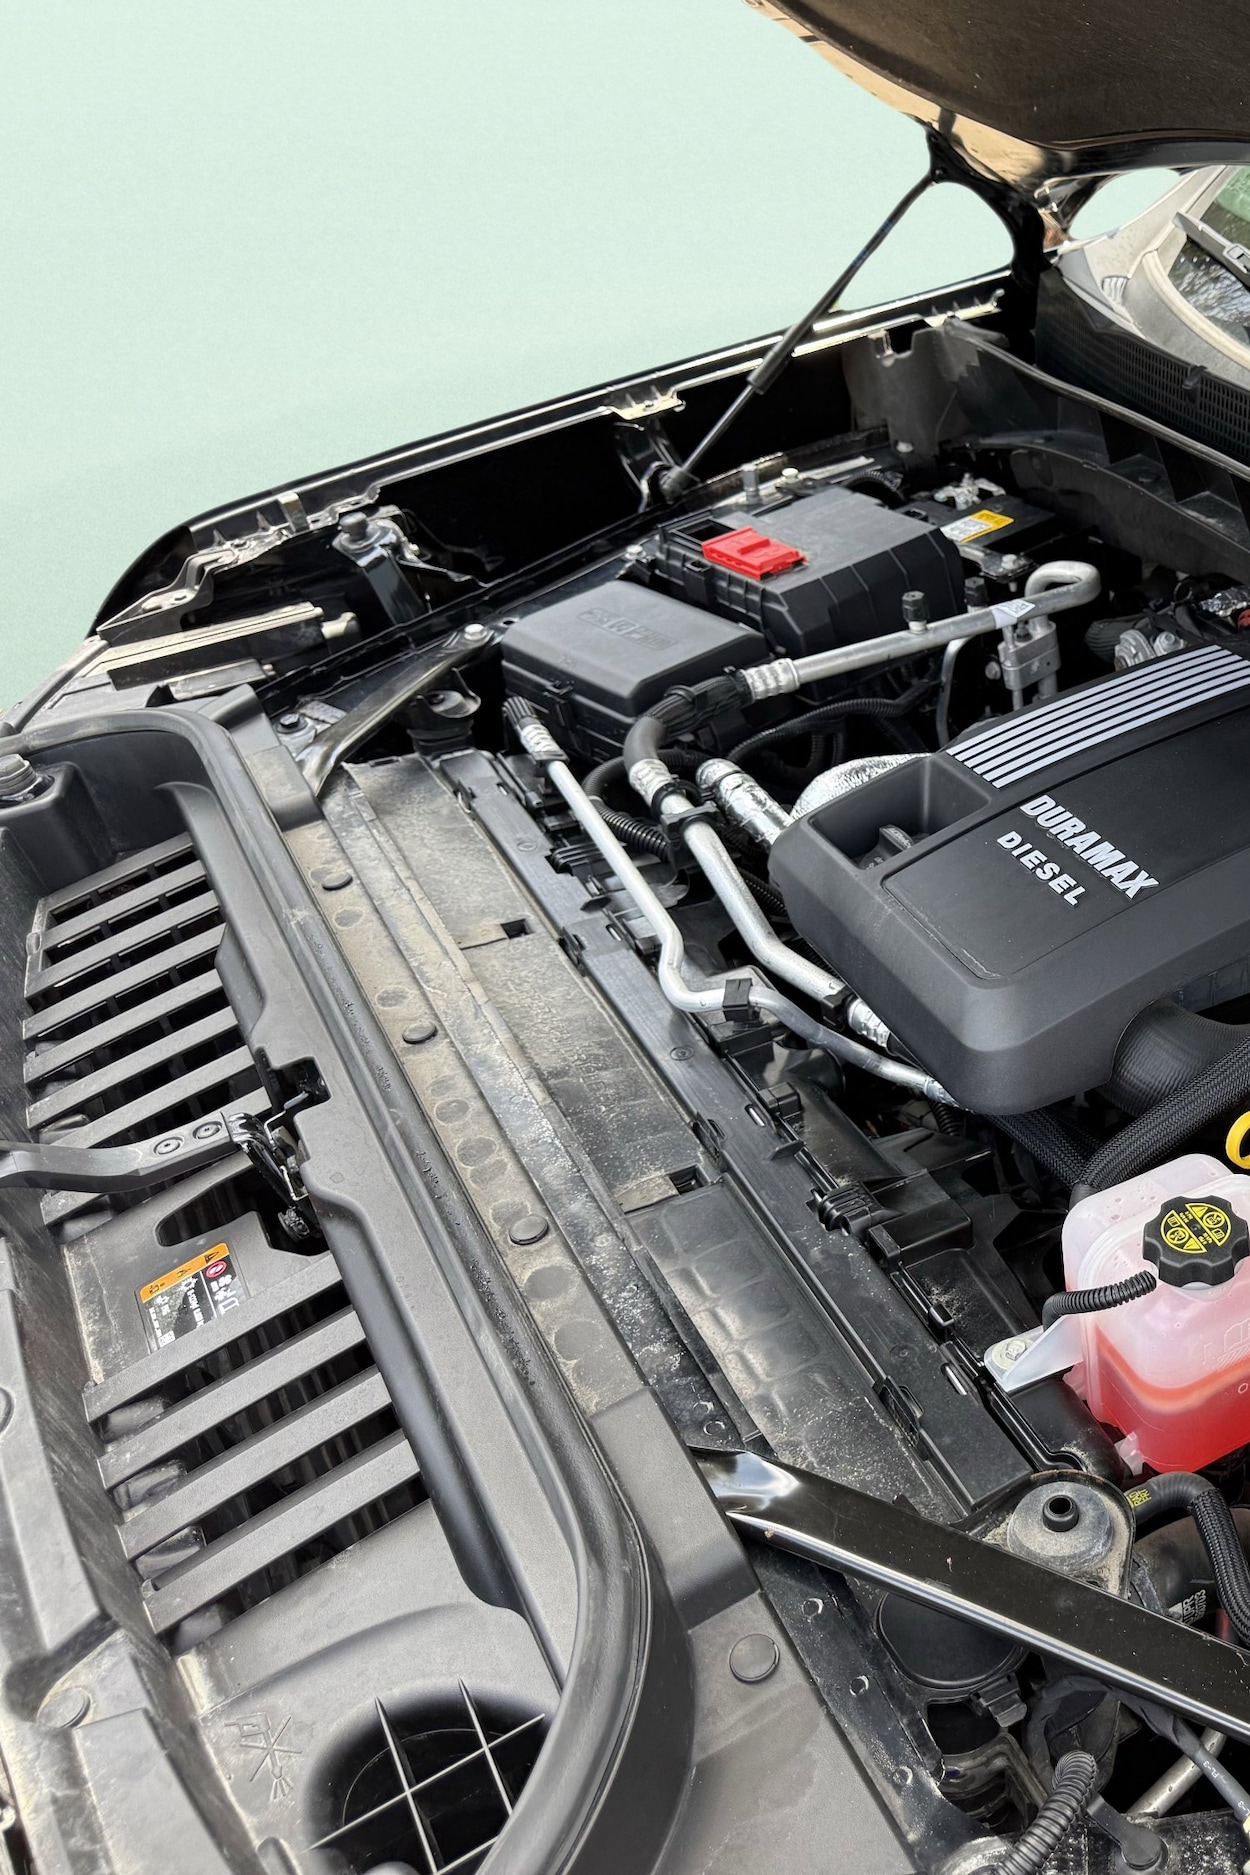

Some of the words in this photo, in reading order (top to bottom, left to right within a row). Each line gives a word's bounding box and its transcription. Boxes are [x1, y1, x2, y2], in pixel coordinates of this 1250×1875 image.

[996, 830, 1086, 906] DIESEL
[1019, 794, 1160, 899] DURAMAX
[1203, 1760, 1219, 1778] FL-3
